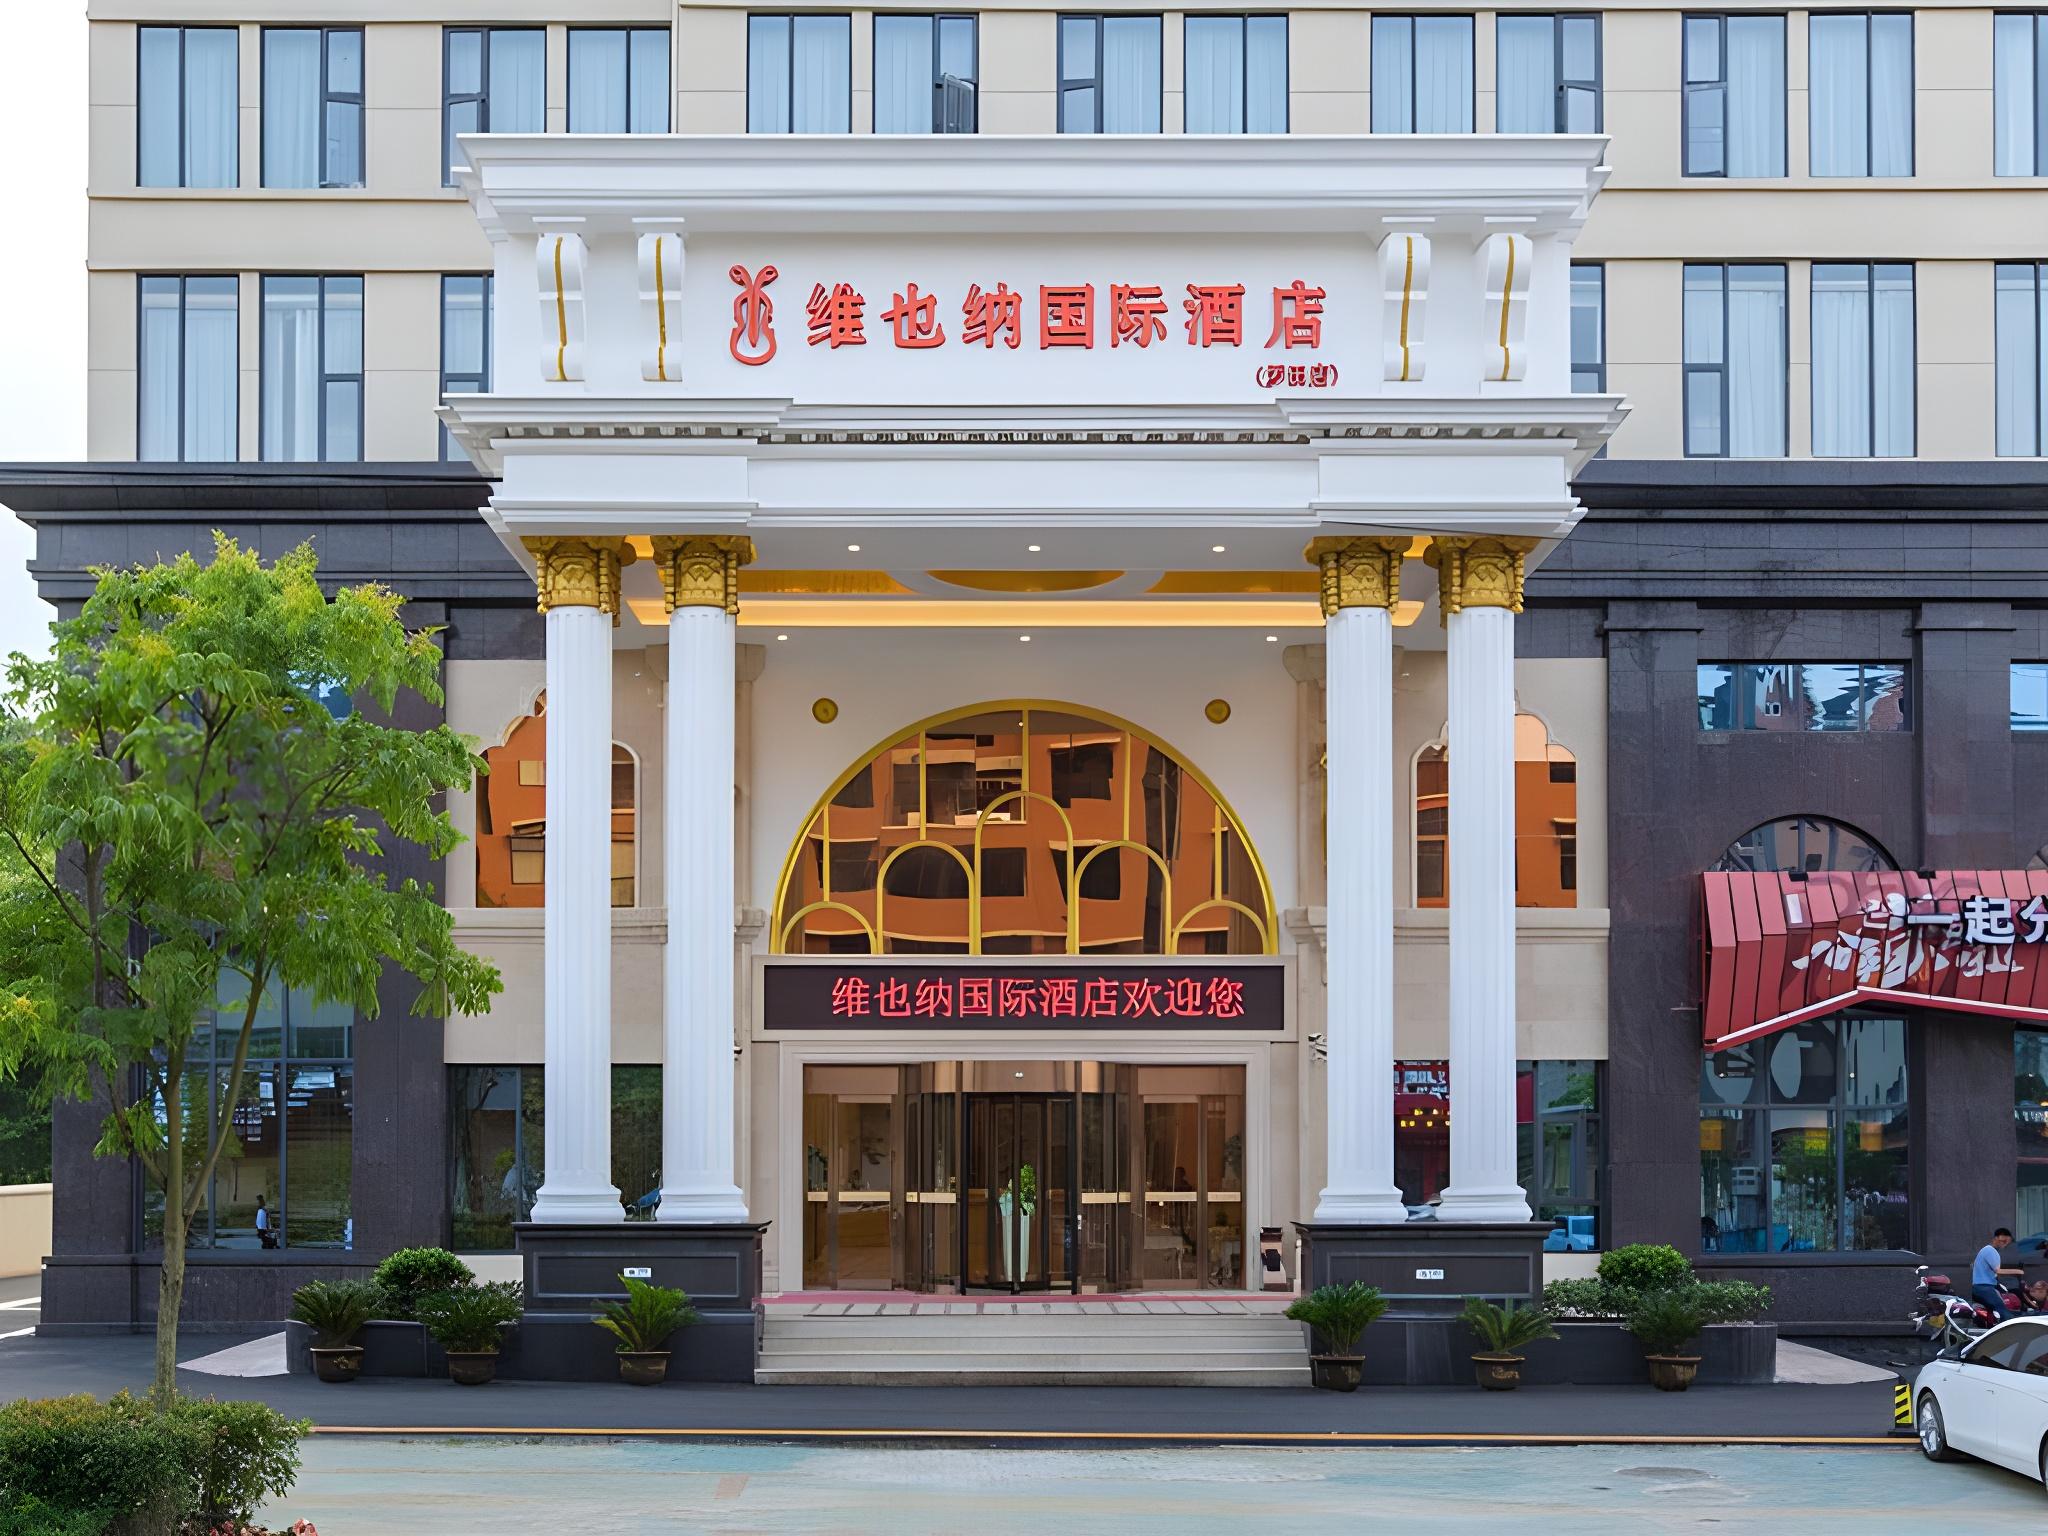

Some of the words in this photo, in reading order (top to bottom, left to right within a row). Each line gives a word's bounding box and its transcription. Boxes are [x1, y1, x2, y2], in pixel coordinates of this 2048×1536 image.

[806, 280, 1326, 349] 维也纳国际酒店
[832, 976, 1244, 1018] 维也纳国际酒店欢迎您
